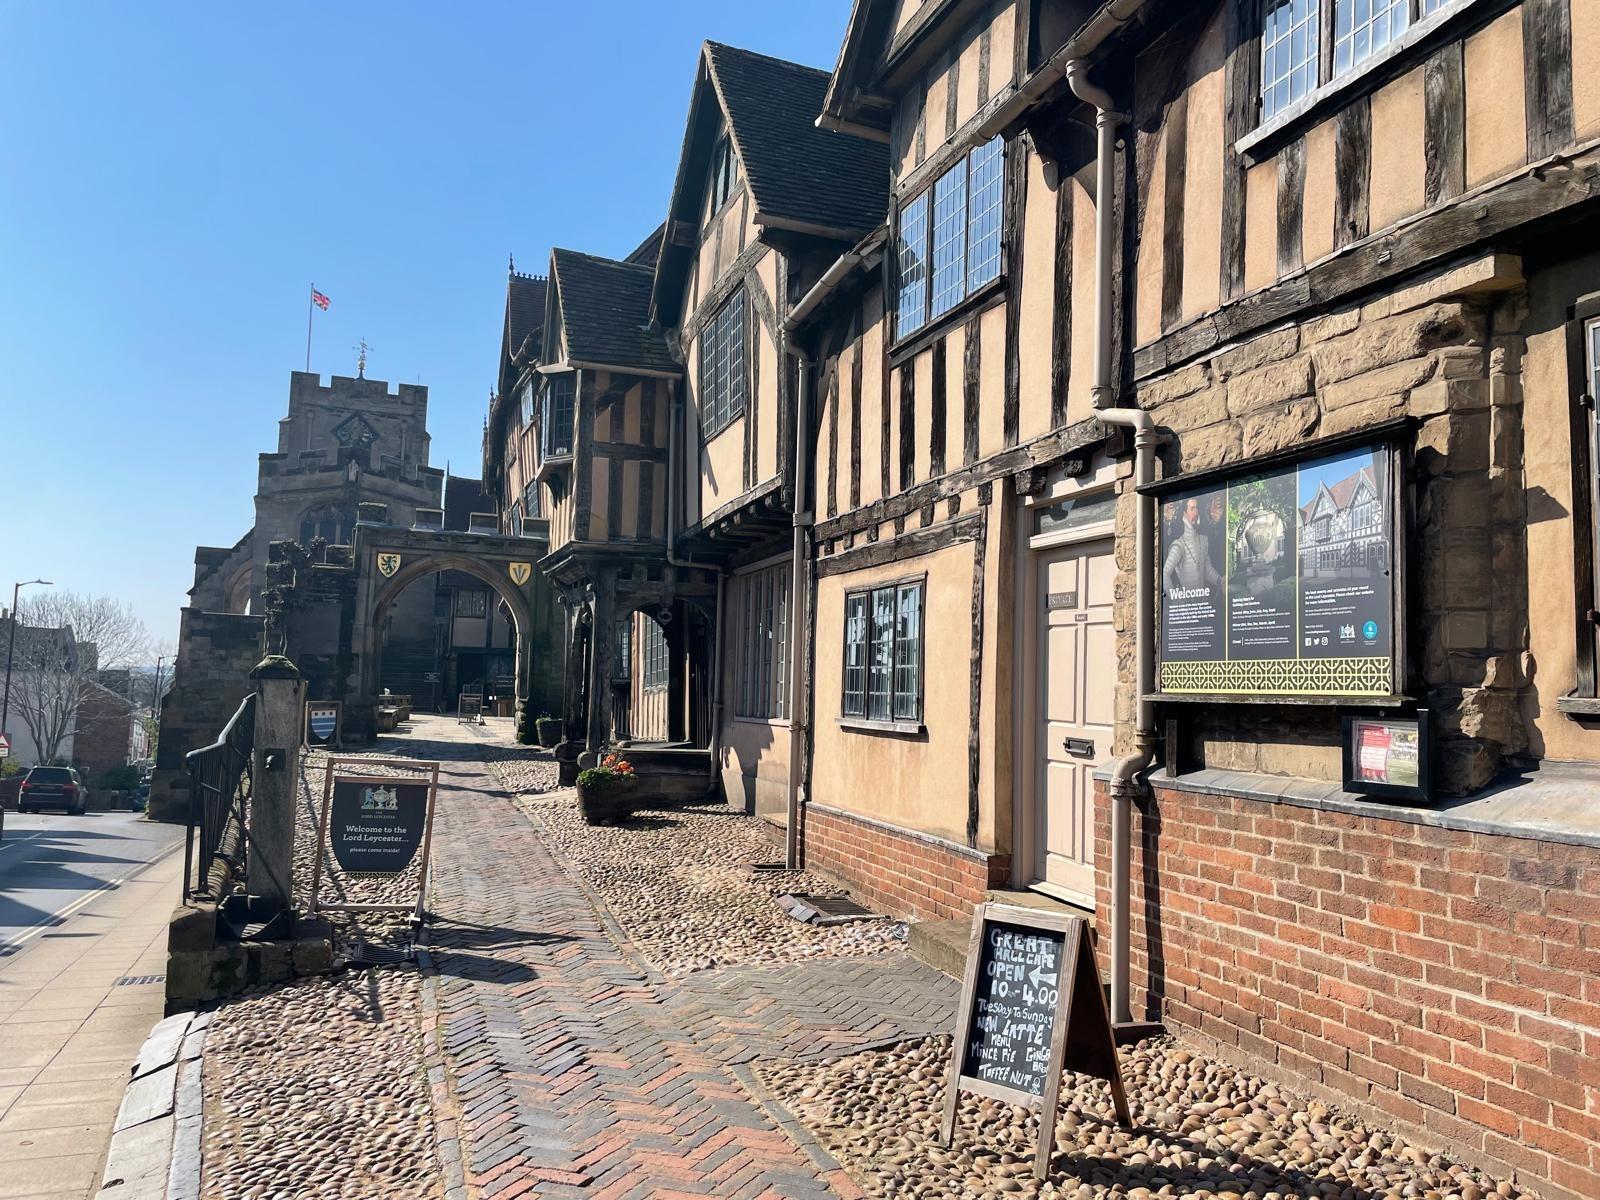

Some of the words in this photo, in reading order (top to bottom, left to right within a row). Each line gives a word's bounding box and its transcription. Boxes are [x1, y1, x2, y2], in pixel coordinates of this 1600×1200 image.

[1170, 587, 1210, 600] Welcome
[346, 825, 382, 833] Welcome
[991, 928, 1053, 954] GREAT
[994, 946, 1025, 962] HALL
[987, 960, 1025, 981] OPEN
[977, 1016, 998, 1032] NEW
[1002, 1019, 1045, 1045] LATTE
[1010, 1071, 1032, 1086] NUT
